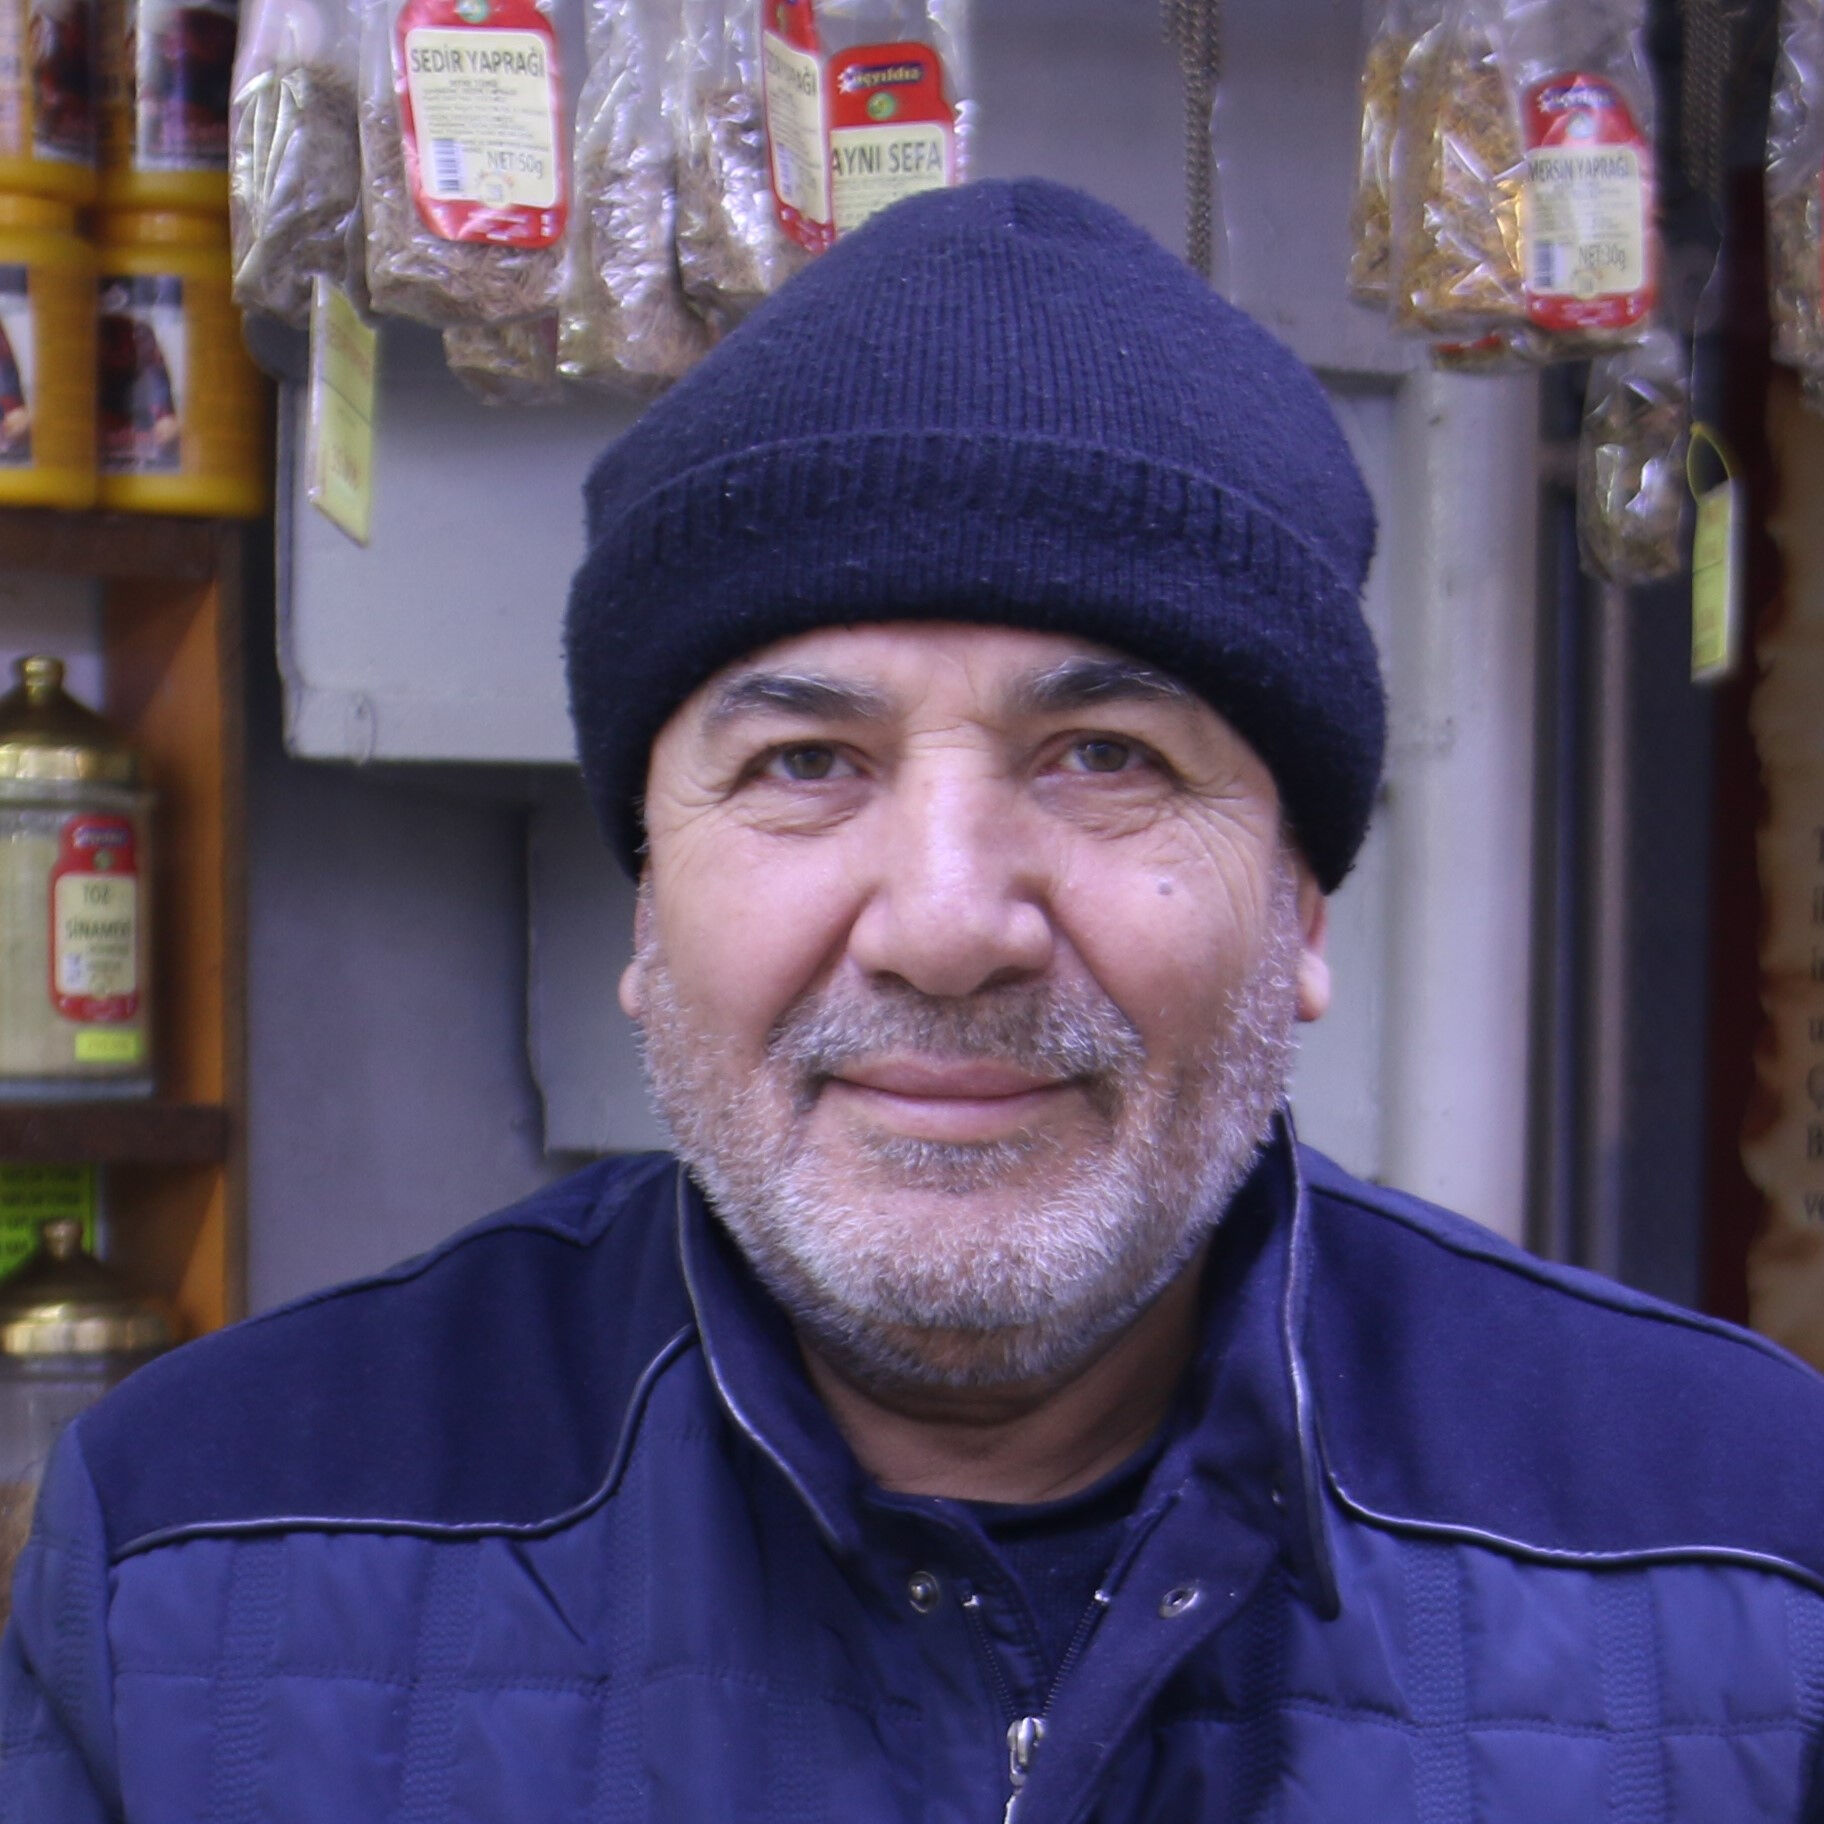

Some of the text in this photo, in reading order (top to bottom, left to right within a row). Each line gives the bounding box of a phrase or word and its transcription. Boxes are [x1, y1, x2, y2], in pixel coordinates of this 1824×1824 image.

[411, 44, 545, 78] SEDİR YAPRAĞI
[887, 141, 943, 175] SEFA
